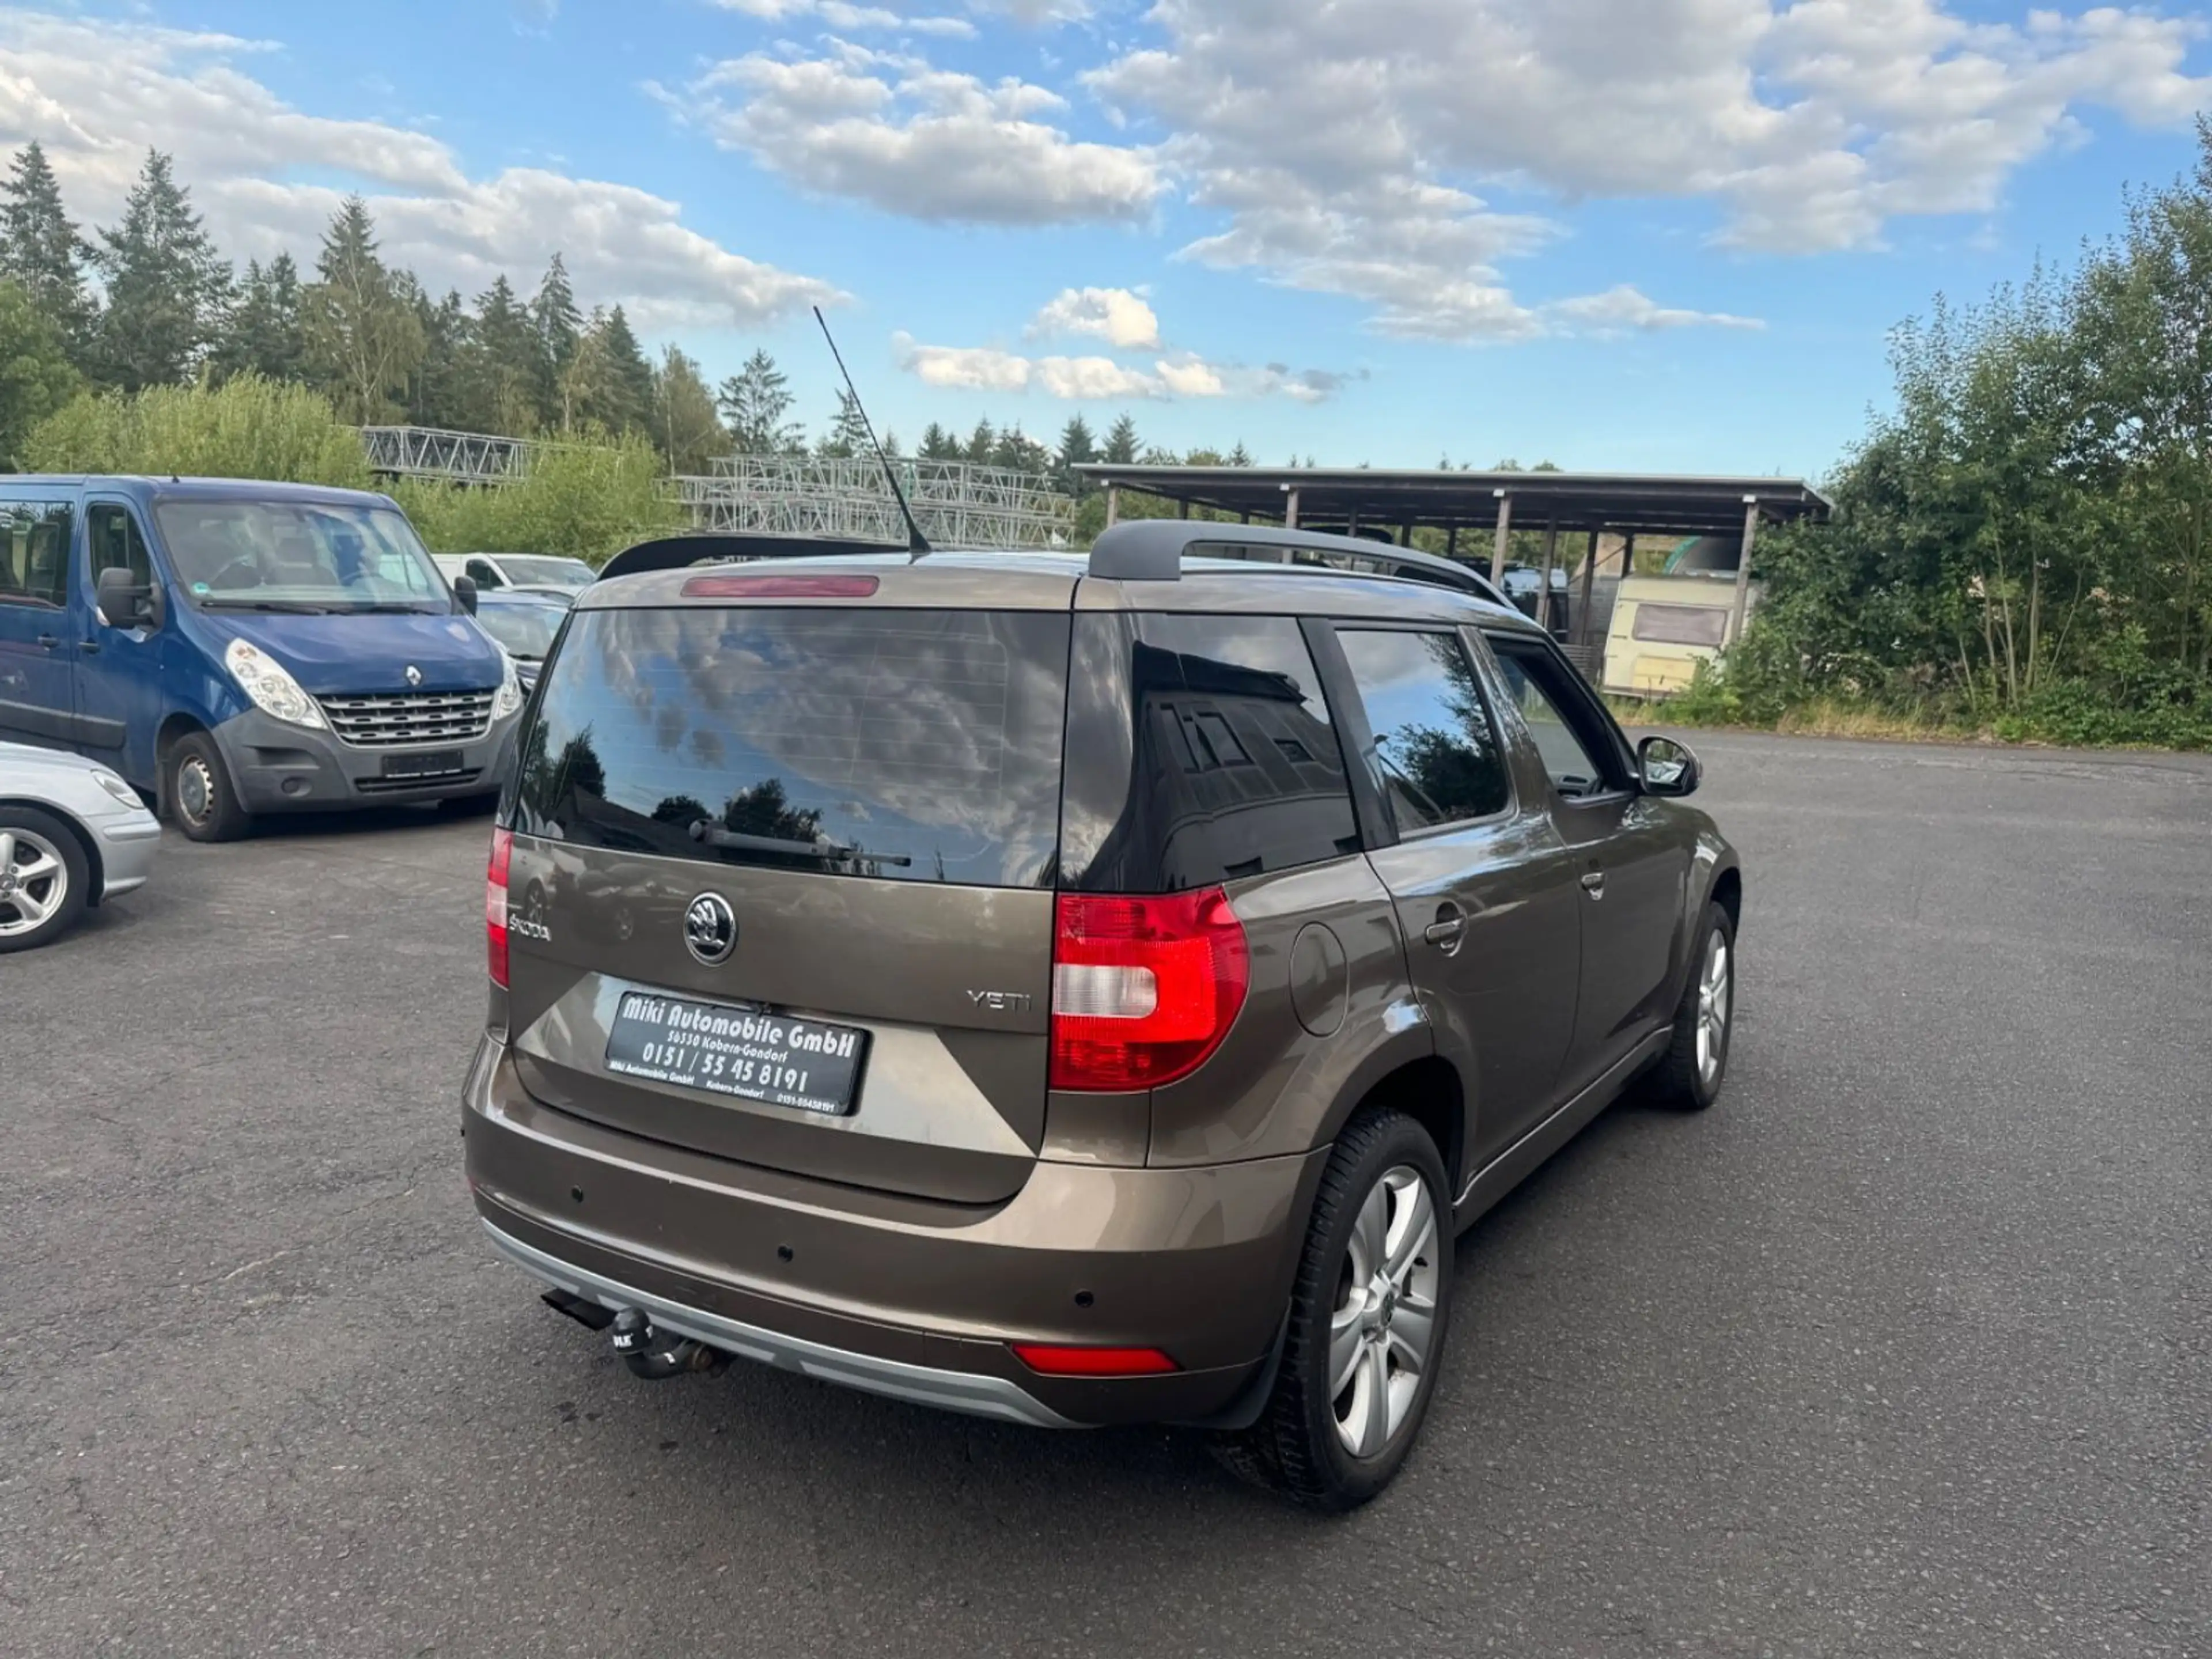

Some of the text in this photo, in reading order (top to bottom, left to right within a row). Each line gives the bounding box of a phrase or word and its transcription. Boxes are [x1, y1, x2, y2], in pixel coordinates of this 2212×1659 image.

[966, 990, 1030, 1010] YETI
[622, 997, 855, 1058] Miki Automobile GmbH
[702, 1036, 788, 1063] Kobern-Gondorf
[642, 1042, 808, 1092] 0151 / 55 45 8191
[669, 1071, 695, 1085] GmbH
